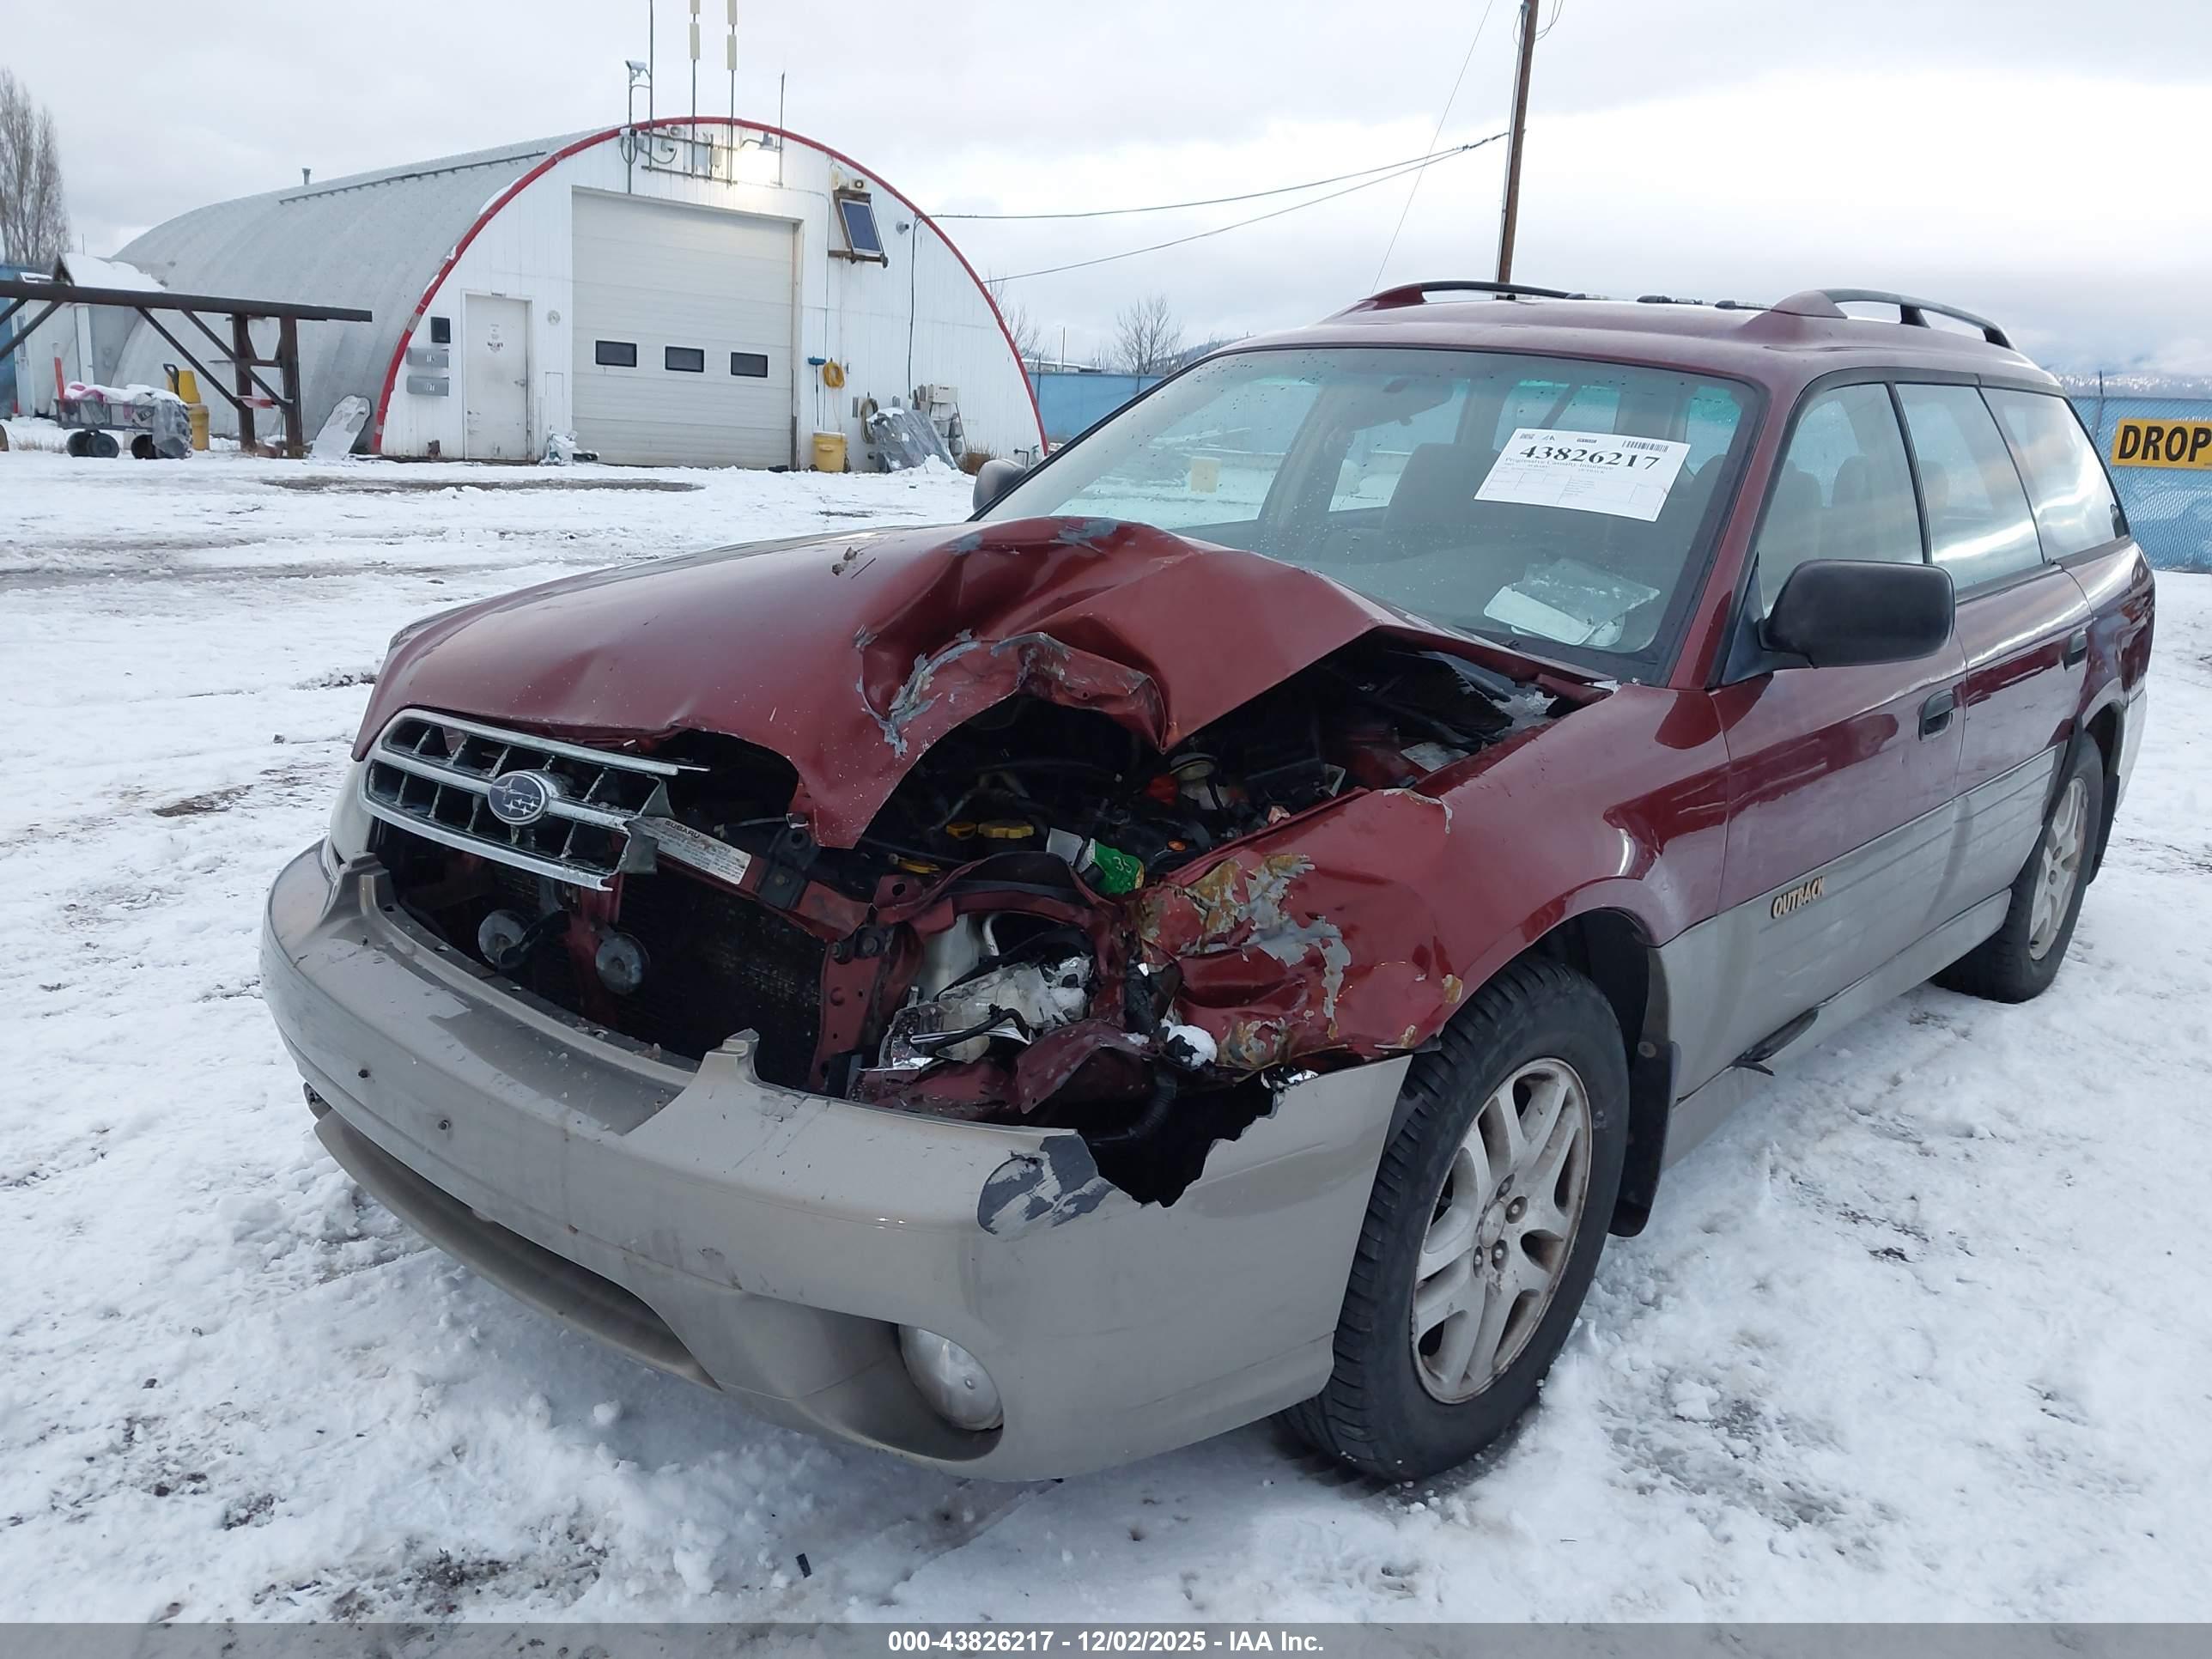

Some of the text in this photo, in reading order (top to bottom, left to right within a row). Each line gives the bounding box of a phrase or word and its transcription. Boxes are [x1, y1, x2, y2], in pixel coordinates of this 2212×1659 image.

[1519, 445, 1660, 471] 43826217
[2118, 424, 2212, 462] DROP
[664, 820, 701, 839] SUBARU
[1771, 876, 1825, 920] OUTBACK
